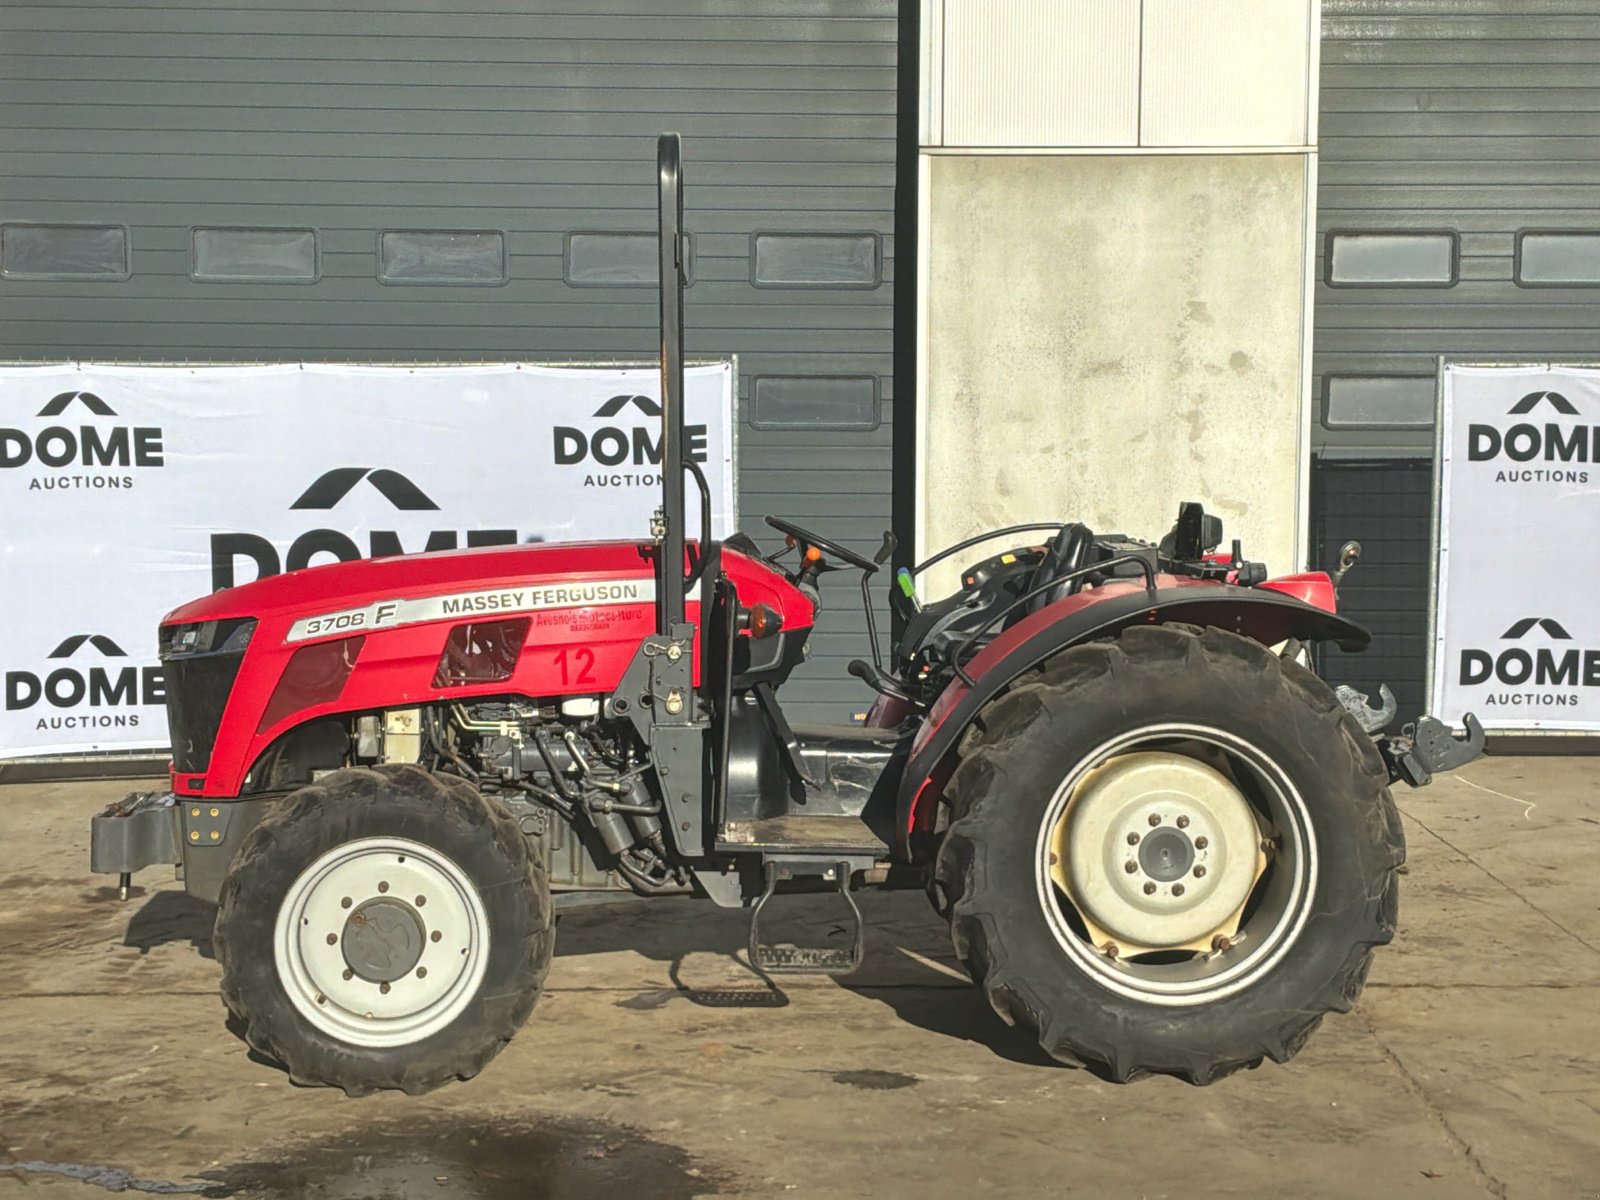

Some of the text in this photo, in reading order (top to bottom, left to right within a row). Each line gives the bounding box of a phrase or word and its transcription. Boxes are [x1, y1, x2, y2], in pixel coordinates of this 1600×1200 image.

[0, 425, 164, 468] DOME
[1468, 423, 1600, 463] DOM
[29, 476, 133, 490] AUCTIONS
[583, 474, 663, 487] AUCTION
[1495, 470, 1588, 483] AUCTIONS
[306, 583, 638, 635] 3708 F MASSEY FERGUSON
[553, 648, 597, 686] 12
[5, 667, 167, 711] DOME
[1485, 693, 1578, 706] AUCTIONS
[36, 714, 139, 730] AUCTIONS
